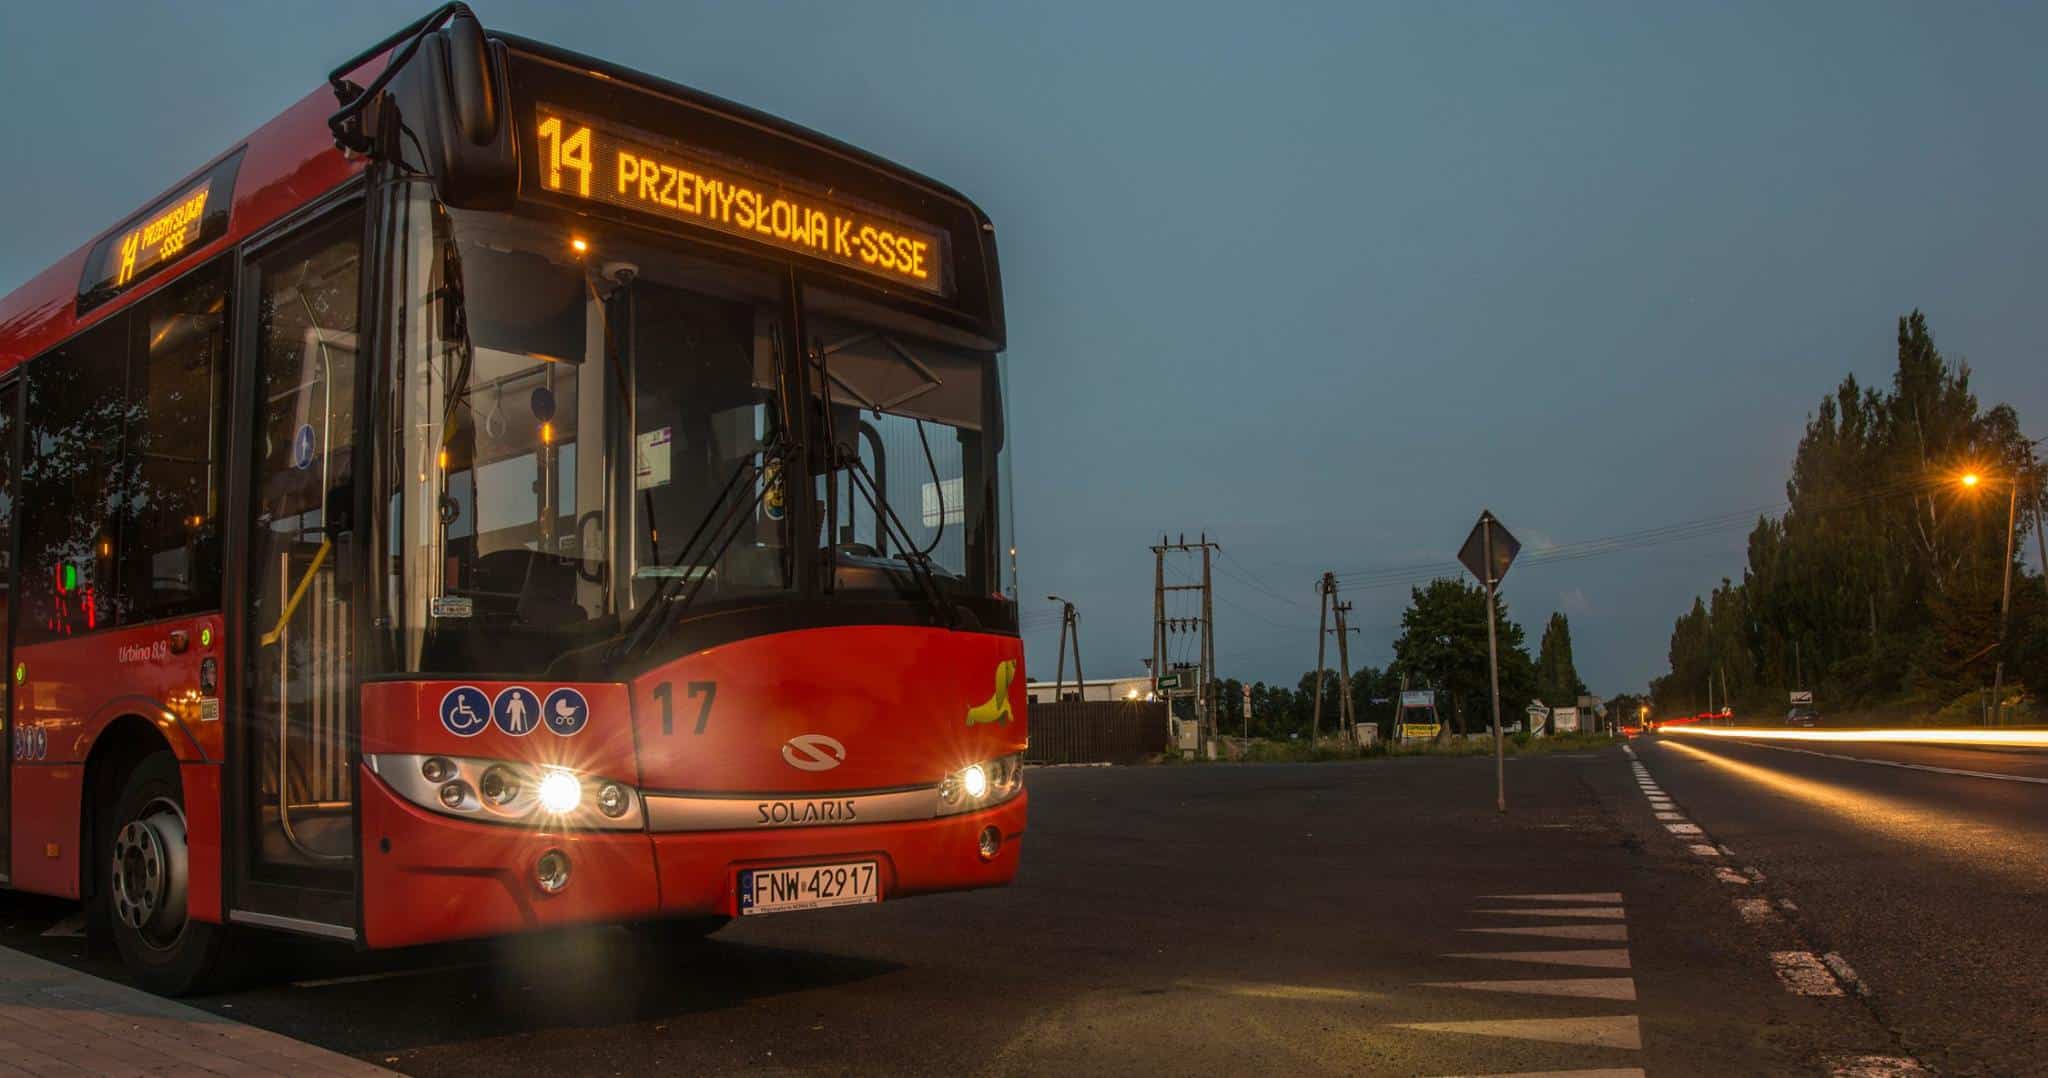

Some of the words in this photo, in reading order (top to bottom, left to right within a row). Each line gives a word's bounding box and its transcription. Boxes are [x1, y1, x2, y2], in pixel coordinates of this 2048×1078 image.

[537, 116, 593, 198] 14
[617, 151, 829, 252] PRZEMYSŁOWA
[835, 216, 929, 279] K-SSSE
[118, 230, 140, 286] 14
[653, 681, 718, 736] 17
[757, 800, 857, 824] SOLARIS
